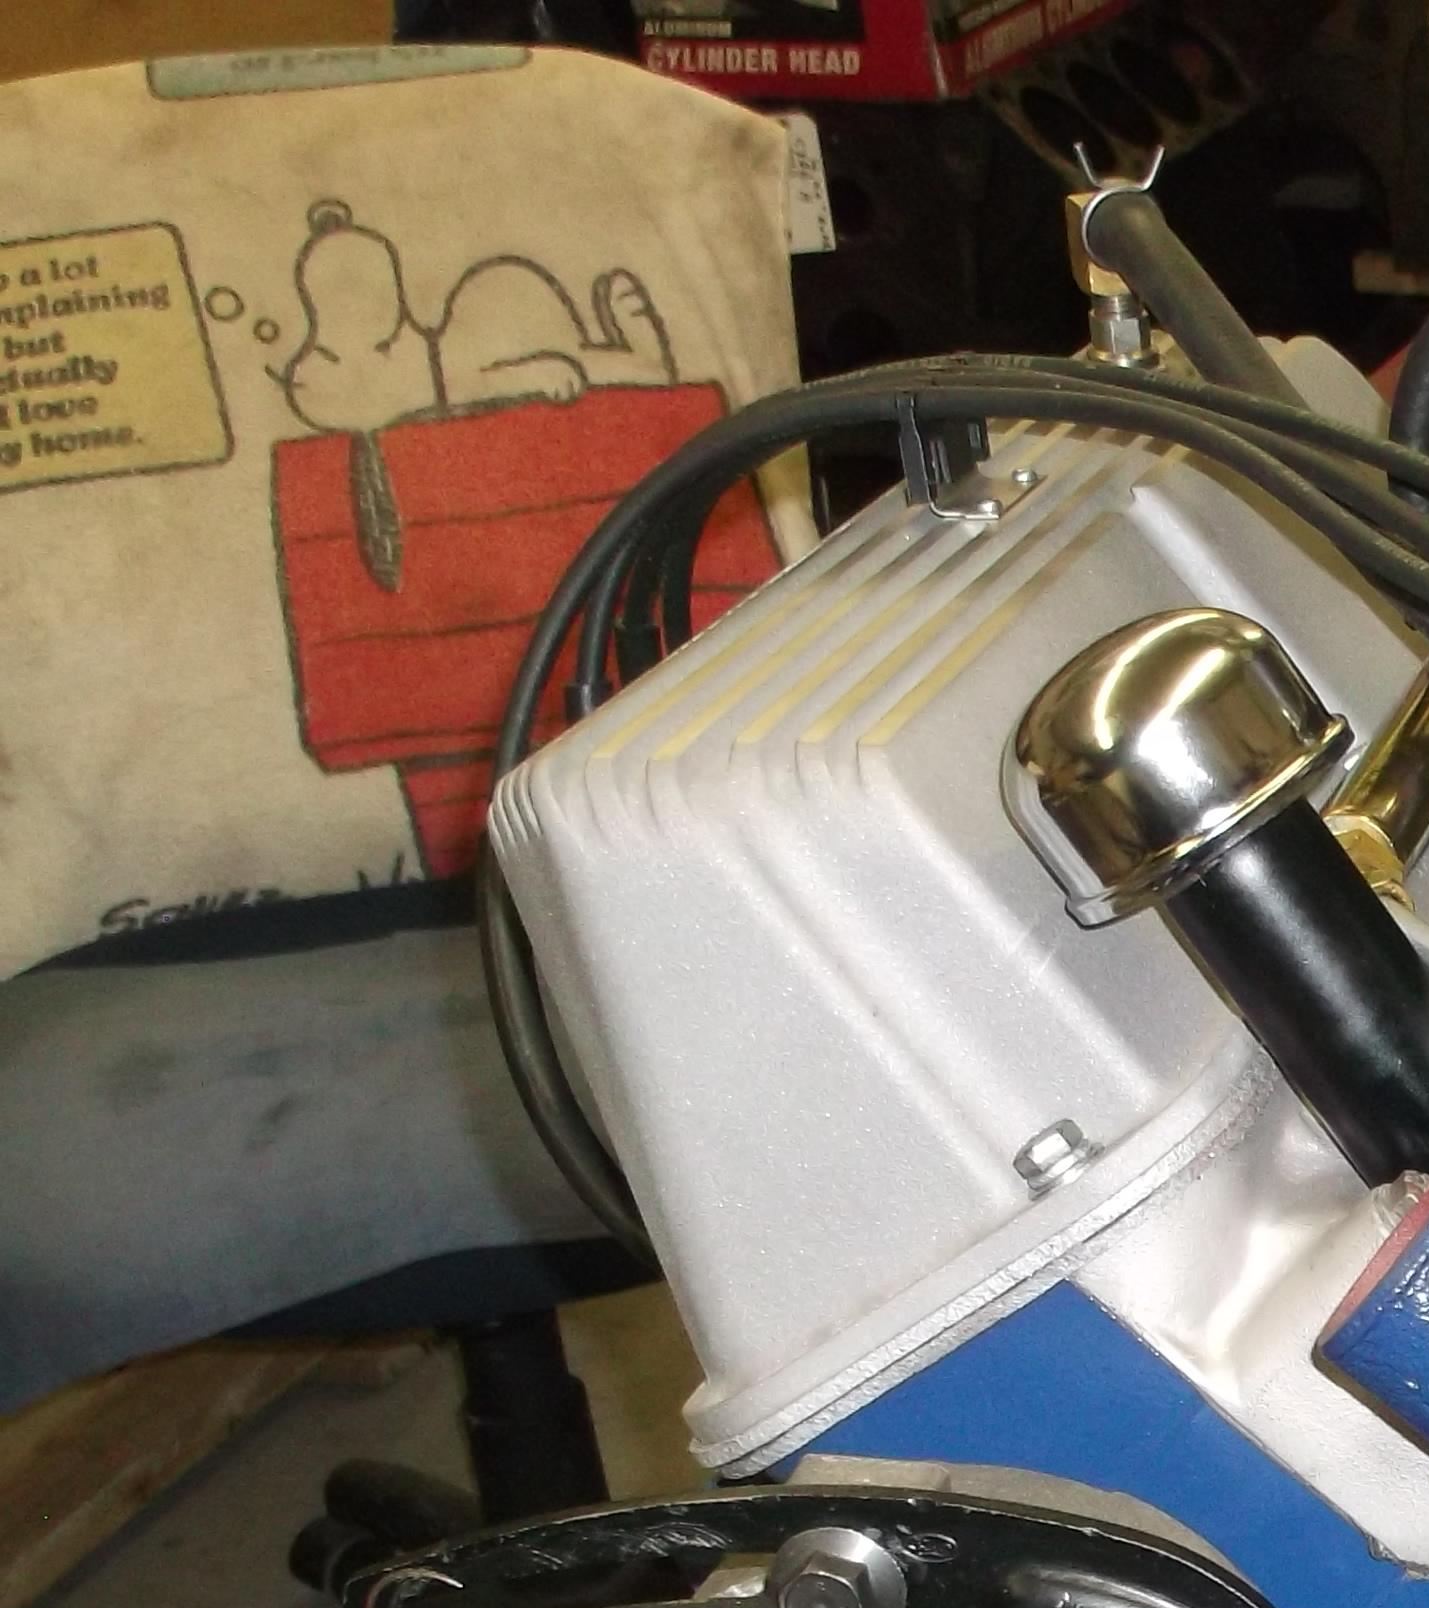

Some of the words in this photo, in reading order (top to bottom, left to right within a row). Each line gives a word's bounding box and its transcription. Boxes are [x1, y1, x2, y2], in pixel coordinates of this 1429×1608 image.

[648, 46, 778, 74] CYLINDER
[789, 48, 861, 75] HEAD
[3, 331, 66, 361] but
